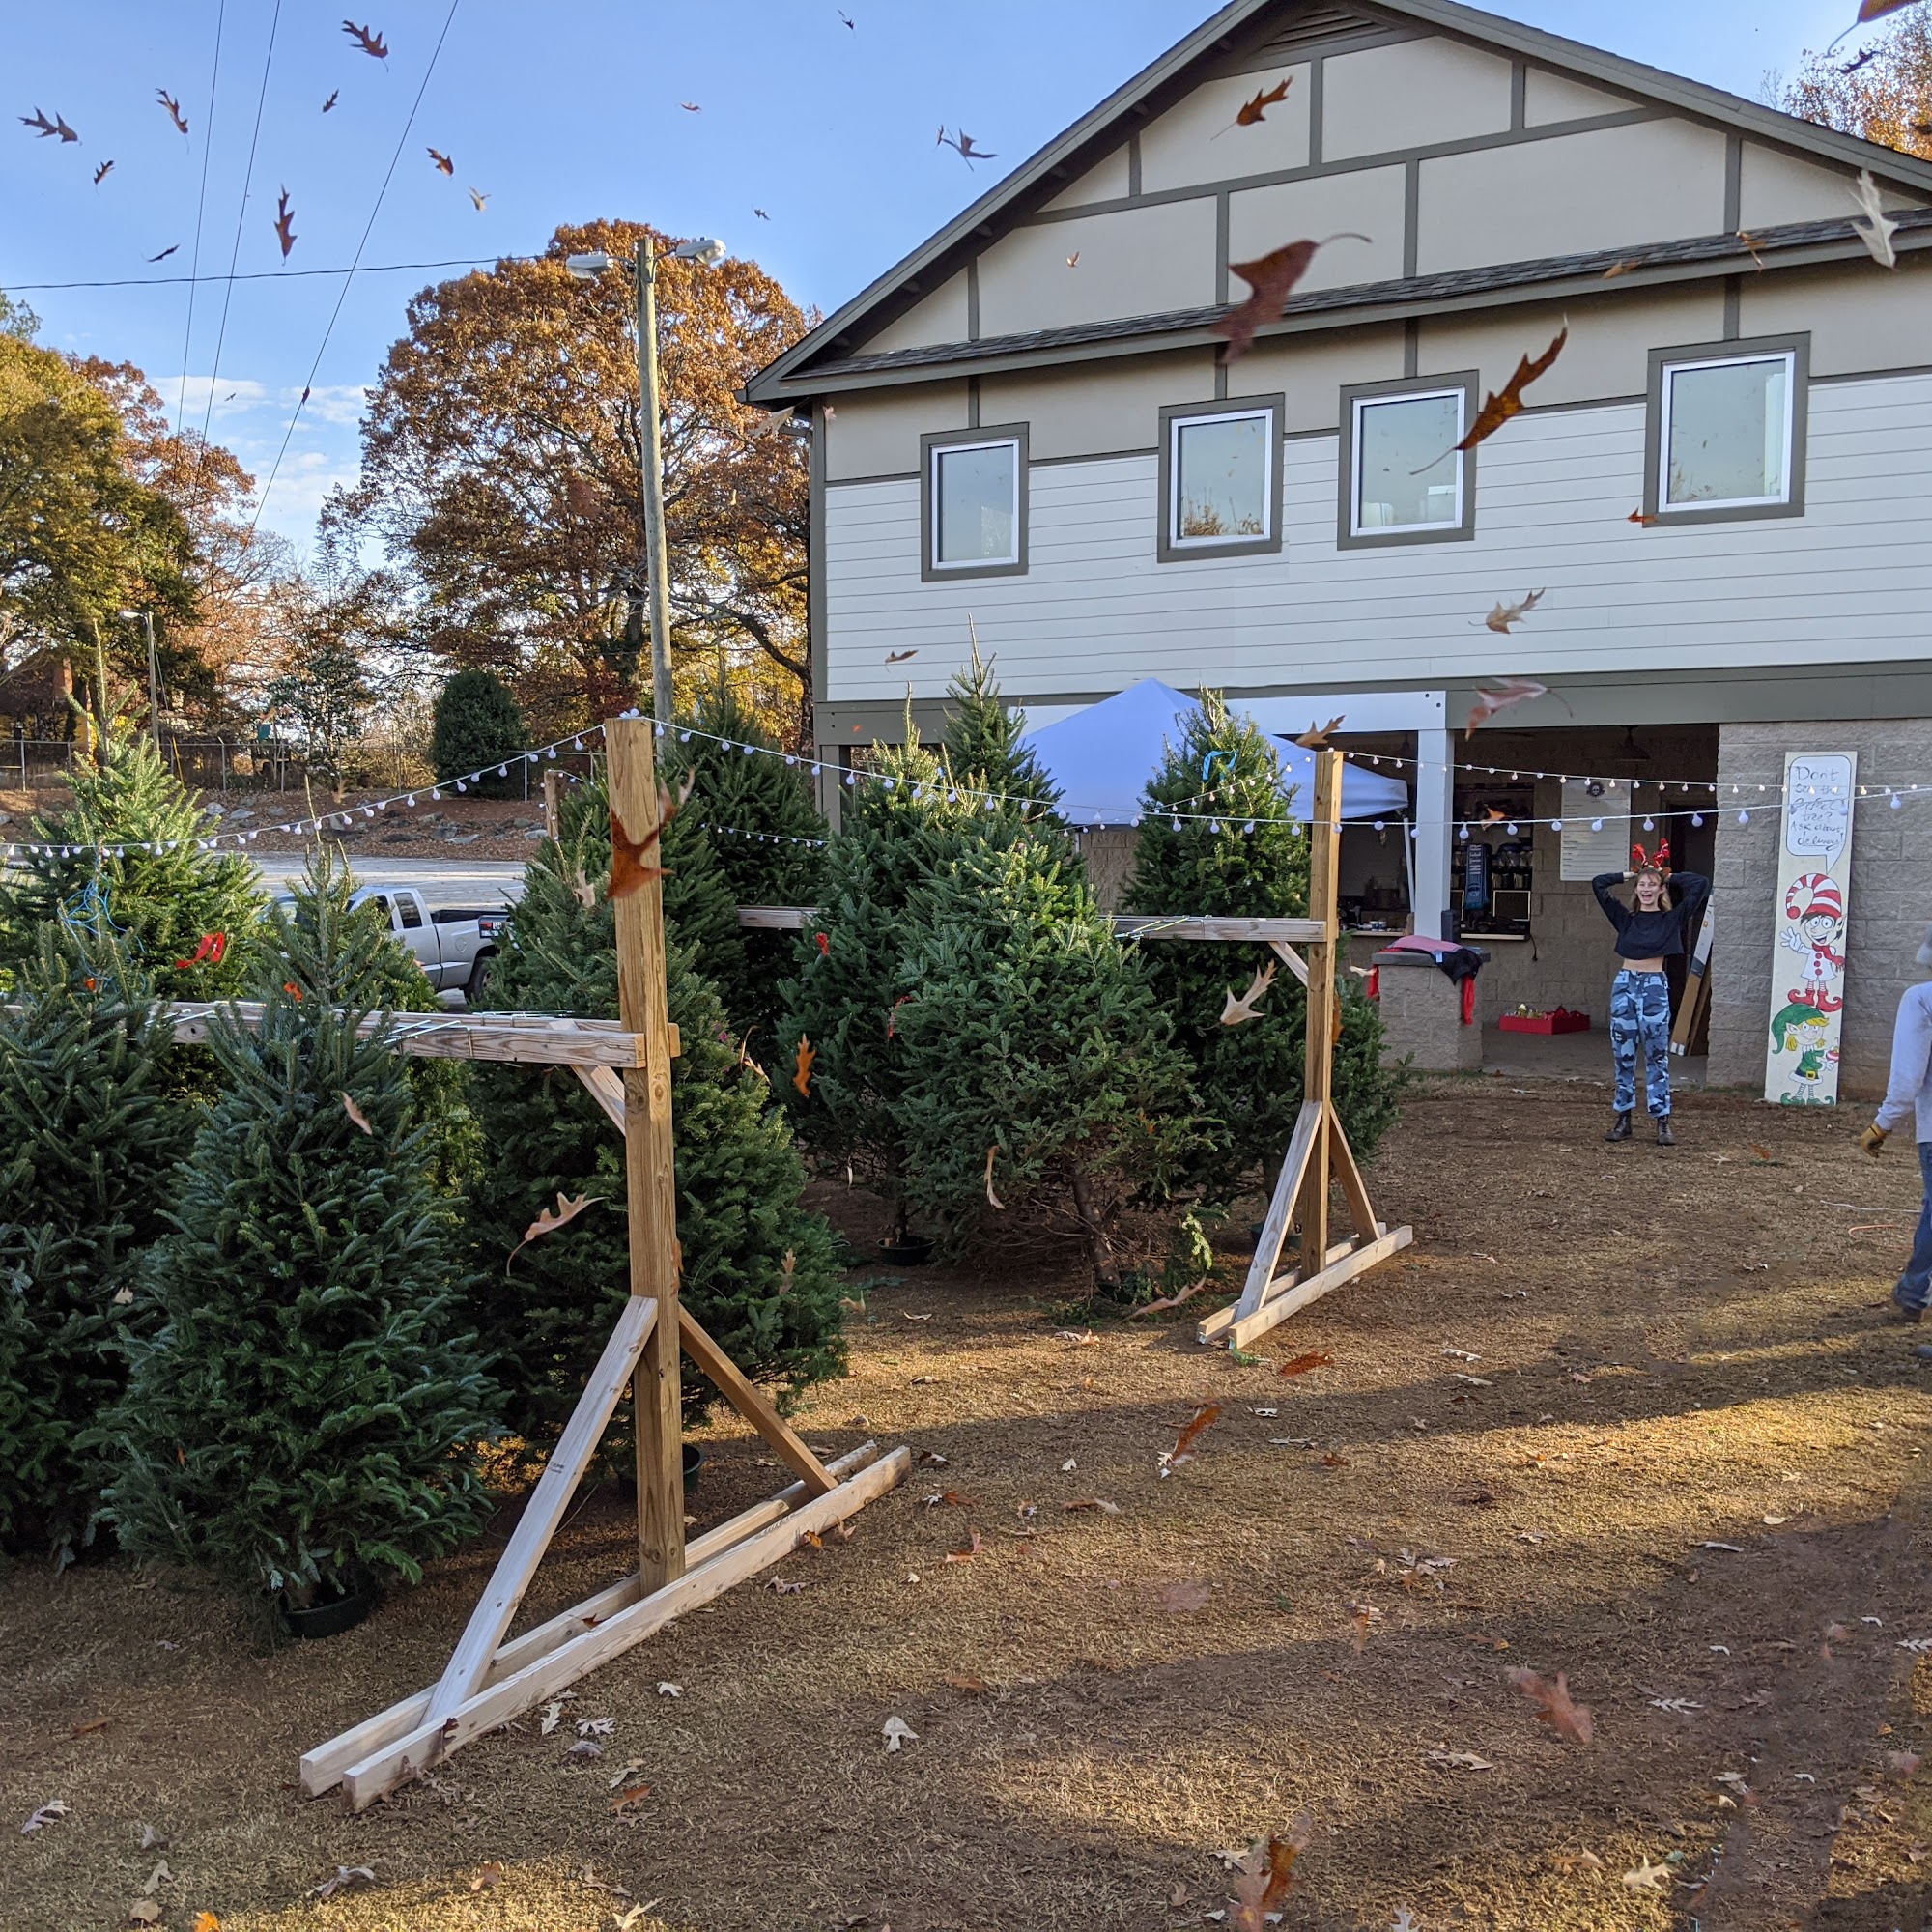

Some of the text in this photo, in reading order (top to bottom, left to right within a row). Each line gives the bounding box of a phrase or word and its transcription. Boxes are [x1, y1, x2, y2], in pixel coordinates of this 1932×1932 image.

[1802, 810, 1833, 822] tree?
[1791, 821, 1843, 833] Ask about
[1797, 831, 1844, 851] delivery!
[1469, 844, 1482, 875] INTER
